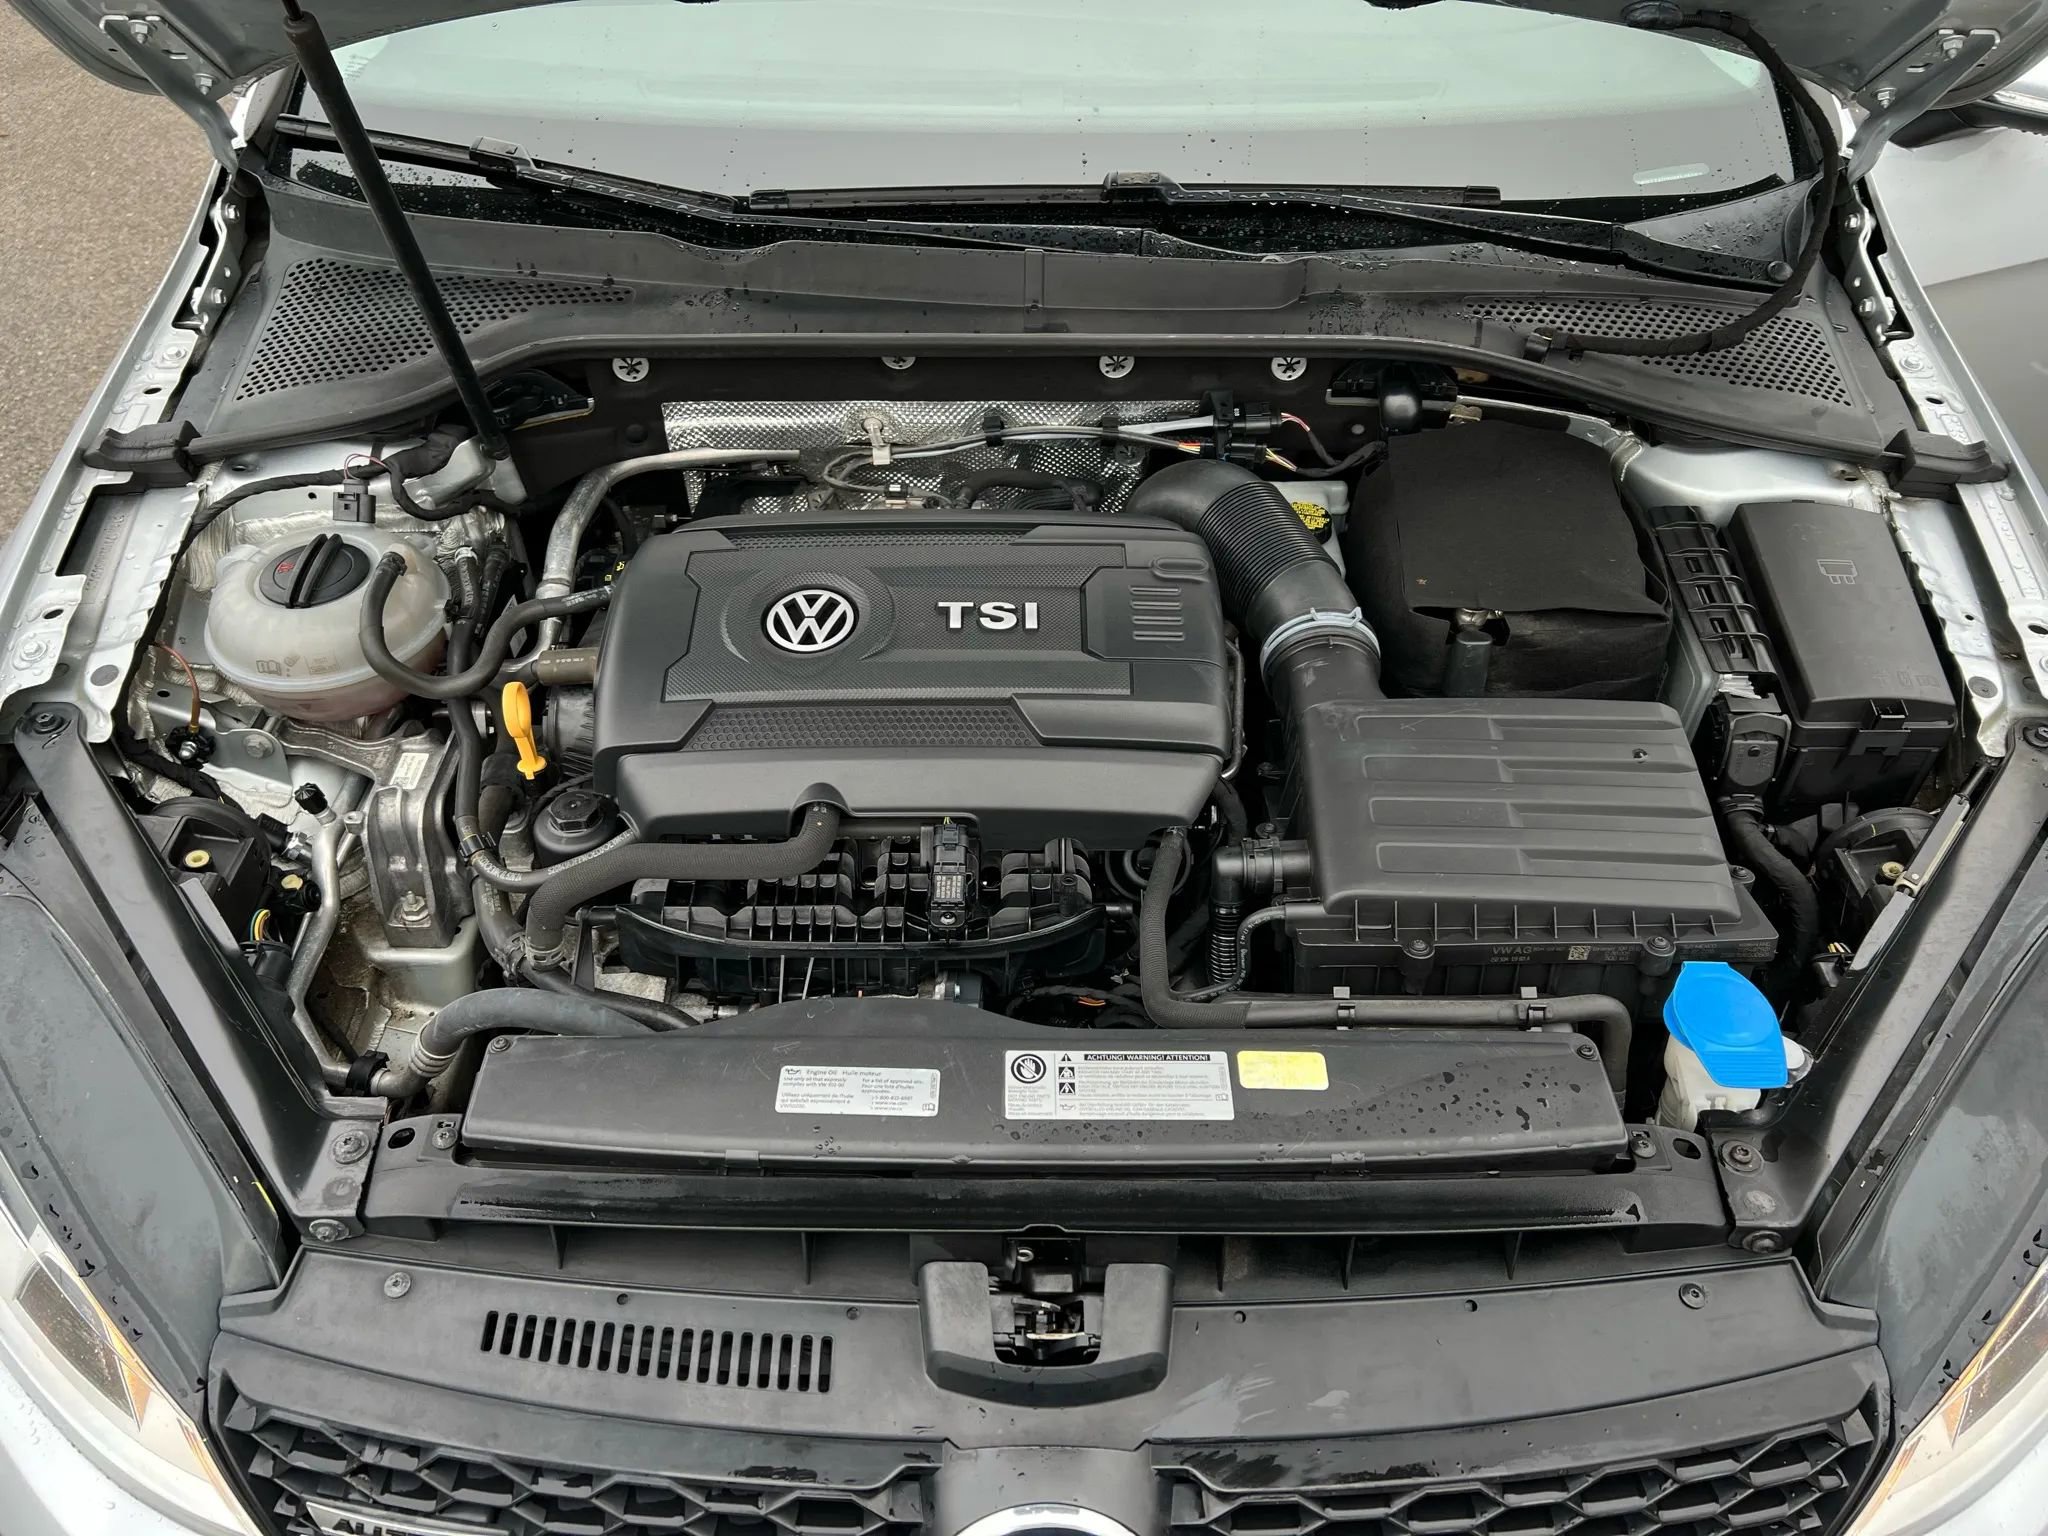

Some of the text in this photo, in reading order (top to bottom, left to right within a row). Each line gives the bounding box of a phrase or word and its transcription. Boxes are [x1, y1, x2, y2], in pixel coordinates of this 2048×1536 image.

[766, 589, 855, 652] VW
[937, 601, 1038, 630] TSI
[1492, 946, 1513, 955] VW
